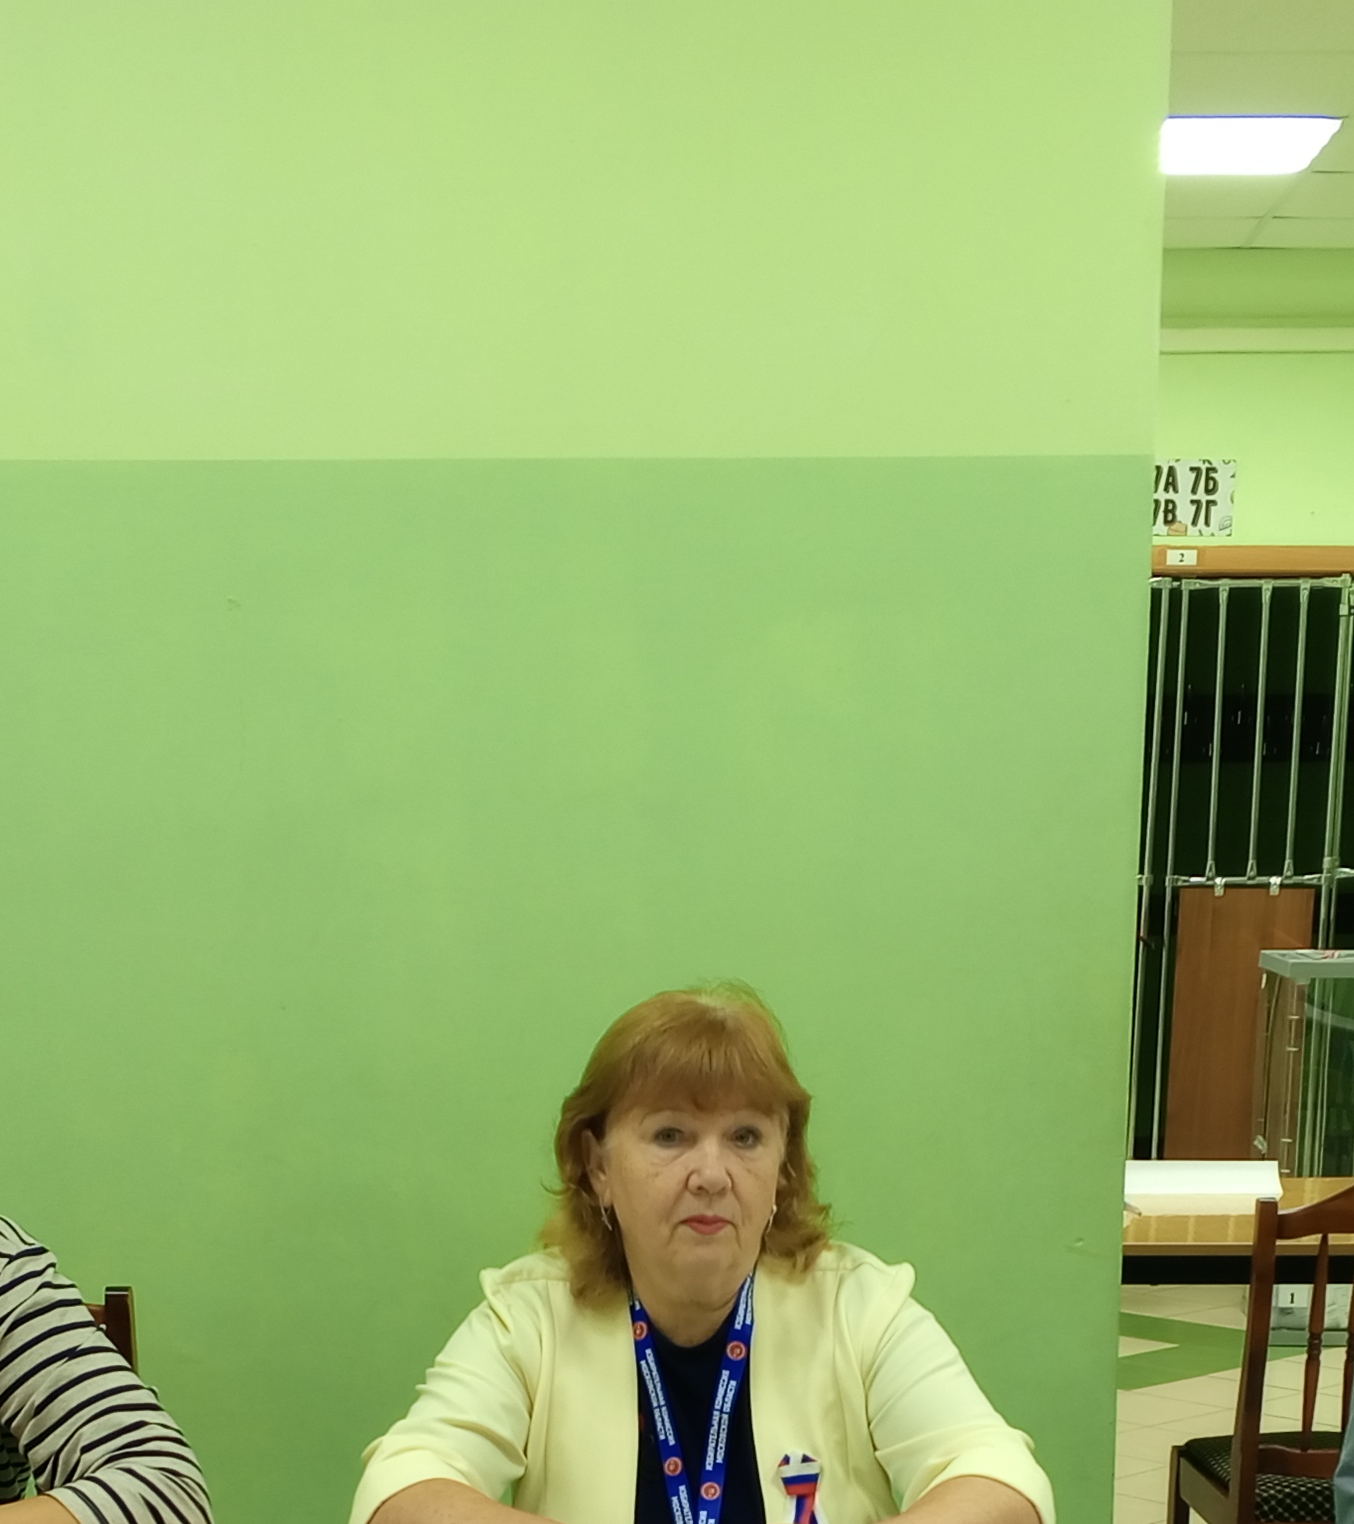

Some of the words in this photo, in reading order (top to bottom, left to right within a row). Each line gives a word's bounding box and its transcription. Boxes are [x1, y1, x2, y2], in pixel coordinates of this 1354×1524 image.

[1189, 466, 1219, 496] 7Б
[1189, 499, 1218, 528] 7Г
[1178, 552, 1185, 563] 2
